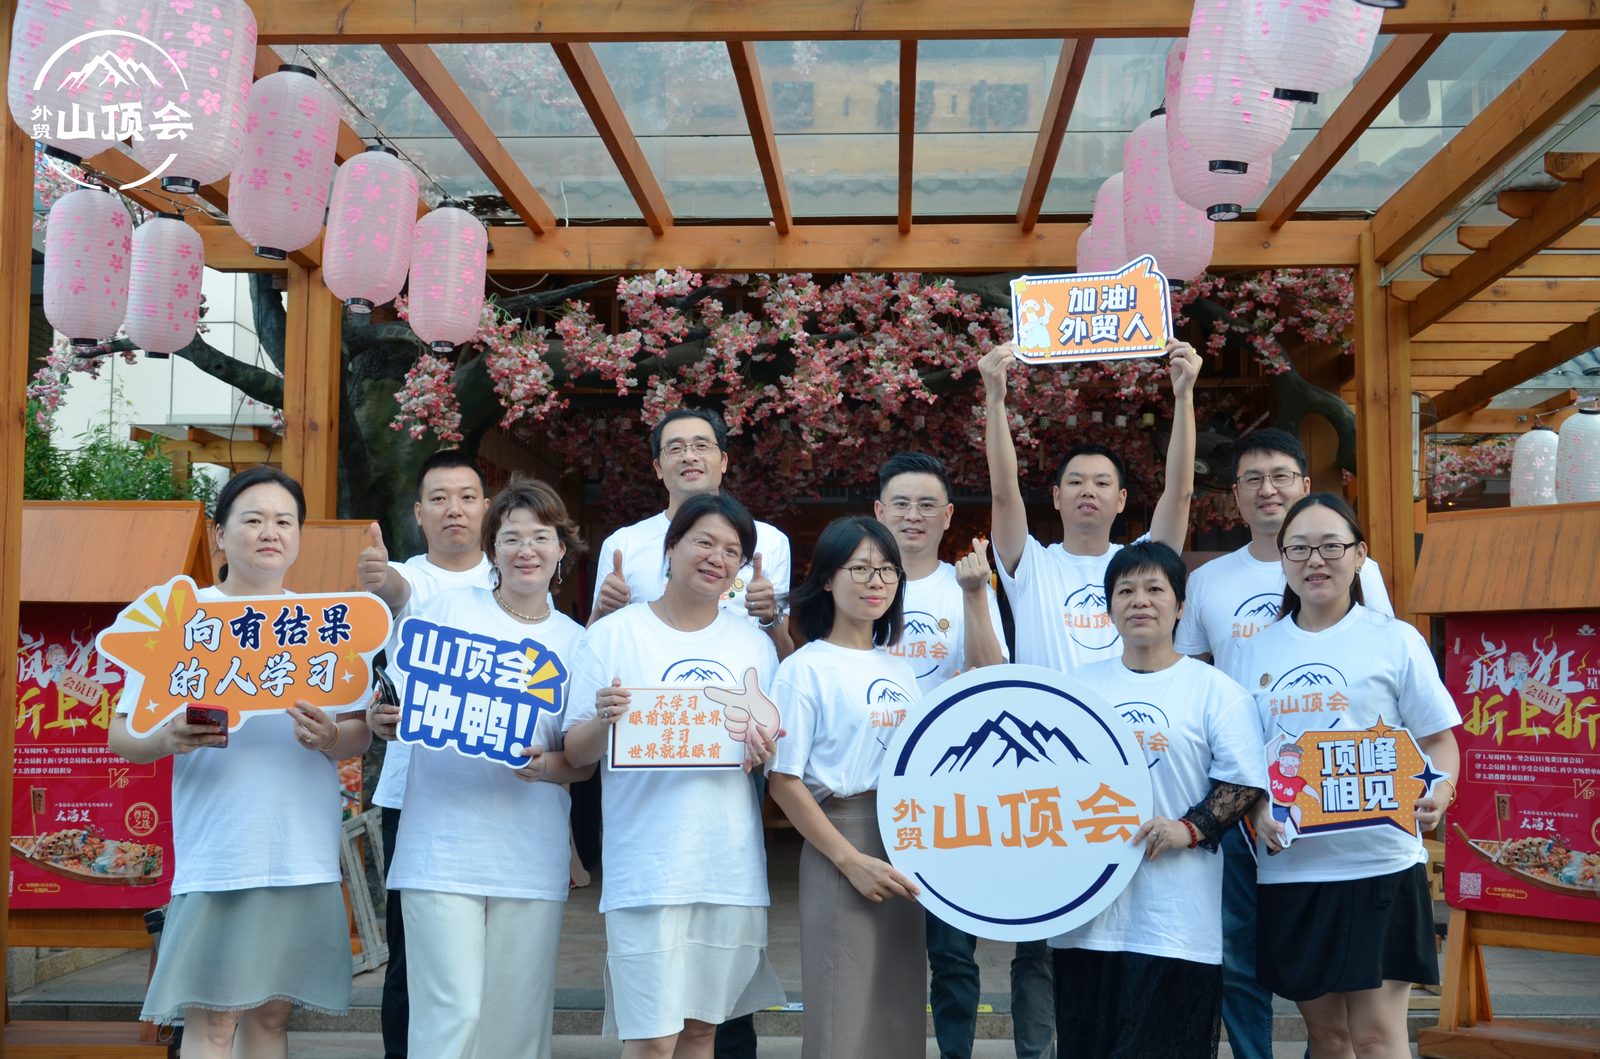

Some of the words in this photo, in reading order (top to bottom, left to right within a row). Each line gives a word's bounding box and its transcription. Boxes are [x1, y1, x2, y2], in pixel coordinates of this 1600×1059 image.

[1068, 284, 1137, 315] 加油!
[1058, 312, 1152, 345] 外贸人
[184, 603, 352, 652] 向有结果
[169, 652, 340, 700] 的人学习
[409, 630, 536, 693] 山顶会
[1462, 632, 1585, 696] 疯狂
[64, 677, 98, 700] 会员日
[654, 694, 698, 710] 不学习
[1280, 691, 1349, 714] 山顶会
[1525, 684, 1561, 709] 会员日
[409, 681, 533, 758] 冲鸭!
[628, 710, 722, 727] 眼前就是世界
[1463, 694, 1600, 750] 折上折
[661, 728, 691, 743] 学习
[627, 744, 722, 760] 世界就在眼前
[1317, 737, 1398, 777] 顶峰
[108, 768, 129, 788] VIP
[1322, 774, 1399, 813] 相见
[1573, 779, 1595, 799] VIP
[893, 799, 928, 851] 外贸
[933, 782, 1140, 850] 山顶会
